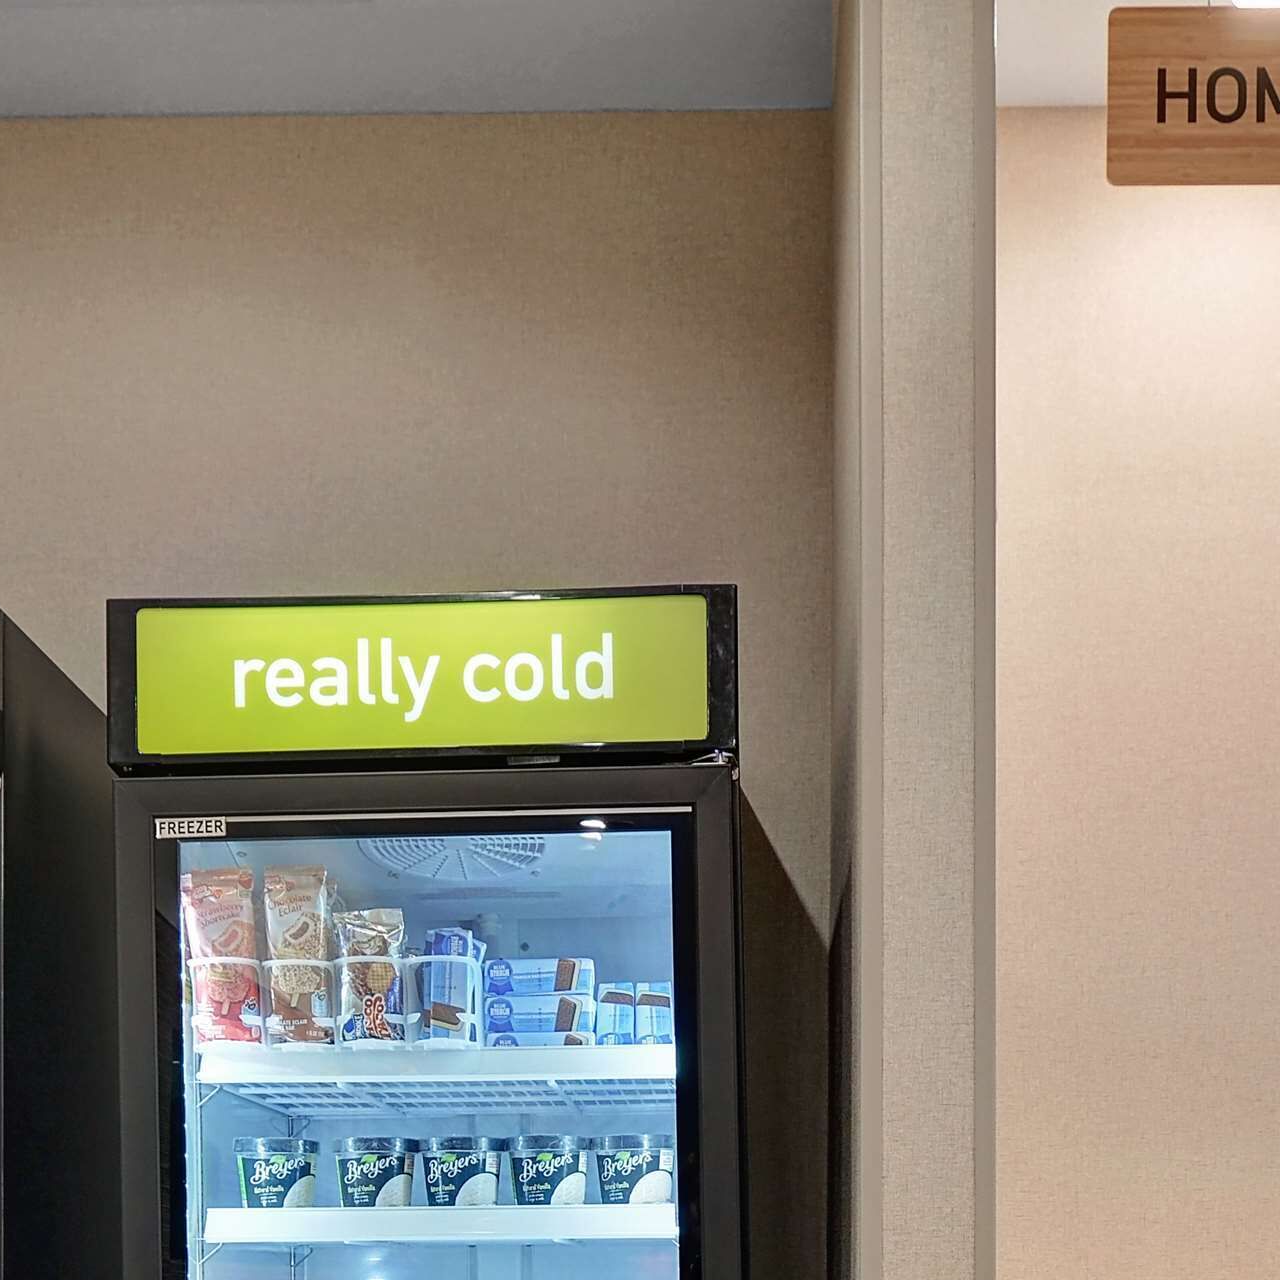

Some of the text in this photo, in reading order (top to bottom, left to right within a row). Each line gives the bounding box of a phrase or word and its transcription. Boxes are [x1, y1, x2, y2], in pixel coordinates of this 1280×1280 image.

[233, 633, 615, 723] really cold
[158, 819, 225, 836] FREEZER
[250, 1158, 304, 1184] Breyers
[344, 1156, 397, 1184] Breyers
[427, 1154, 479, 1183] Breyers
[519, 1152, 573, 1182] Breyers
[602, 1151, 653, 1182] Breyers
